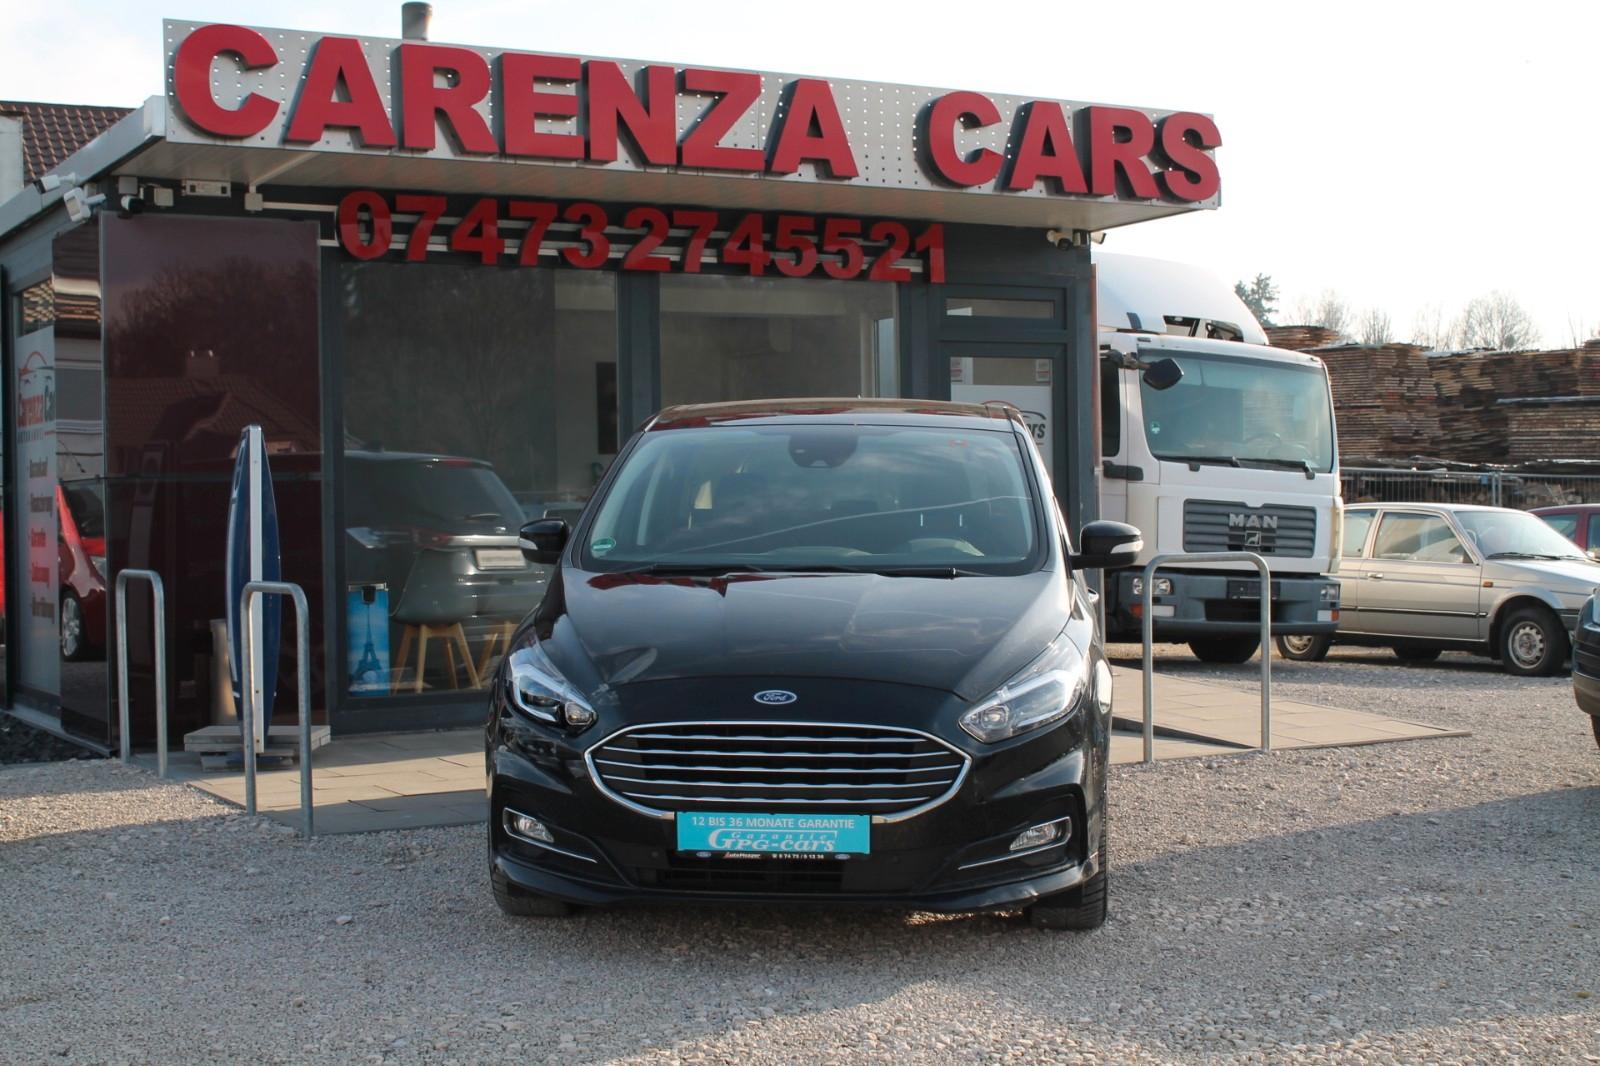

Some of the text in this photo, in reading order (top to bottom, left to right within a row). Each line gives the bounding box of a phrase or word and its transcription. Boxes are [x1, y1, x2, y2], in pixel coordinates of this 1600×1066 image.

[174, 23, 1223, 201] CARENZA CARS
[1229, 513, 1278, 529] MAN
[692, 816, 855, 829] 12 BIS 36 MONATE GARANTIE
[731, 831, 827, 840] Garantie
